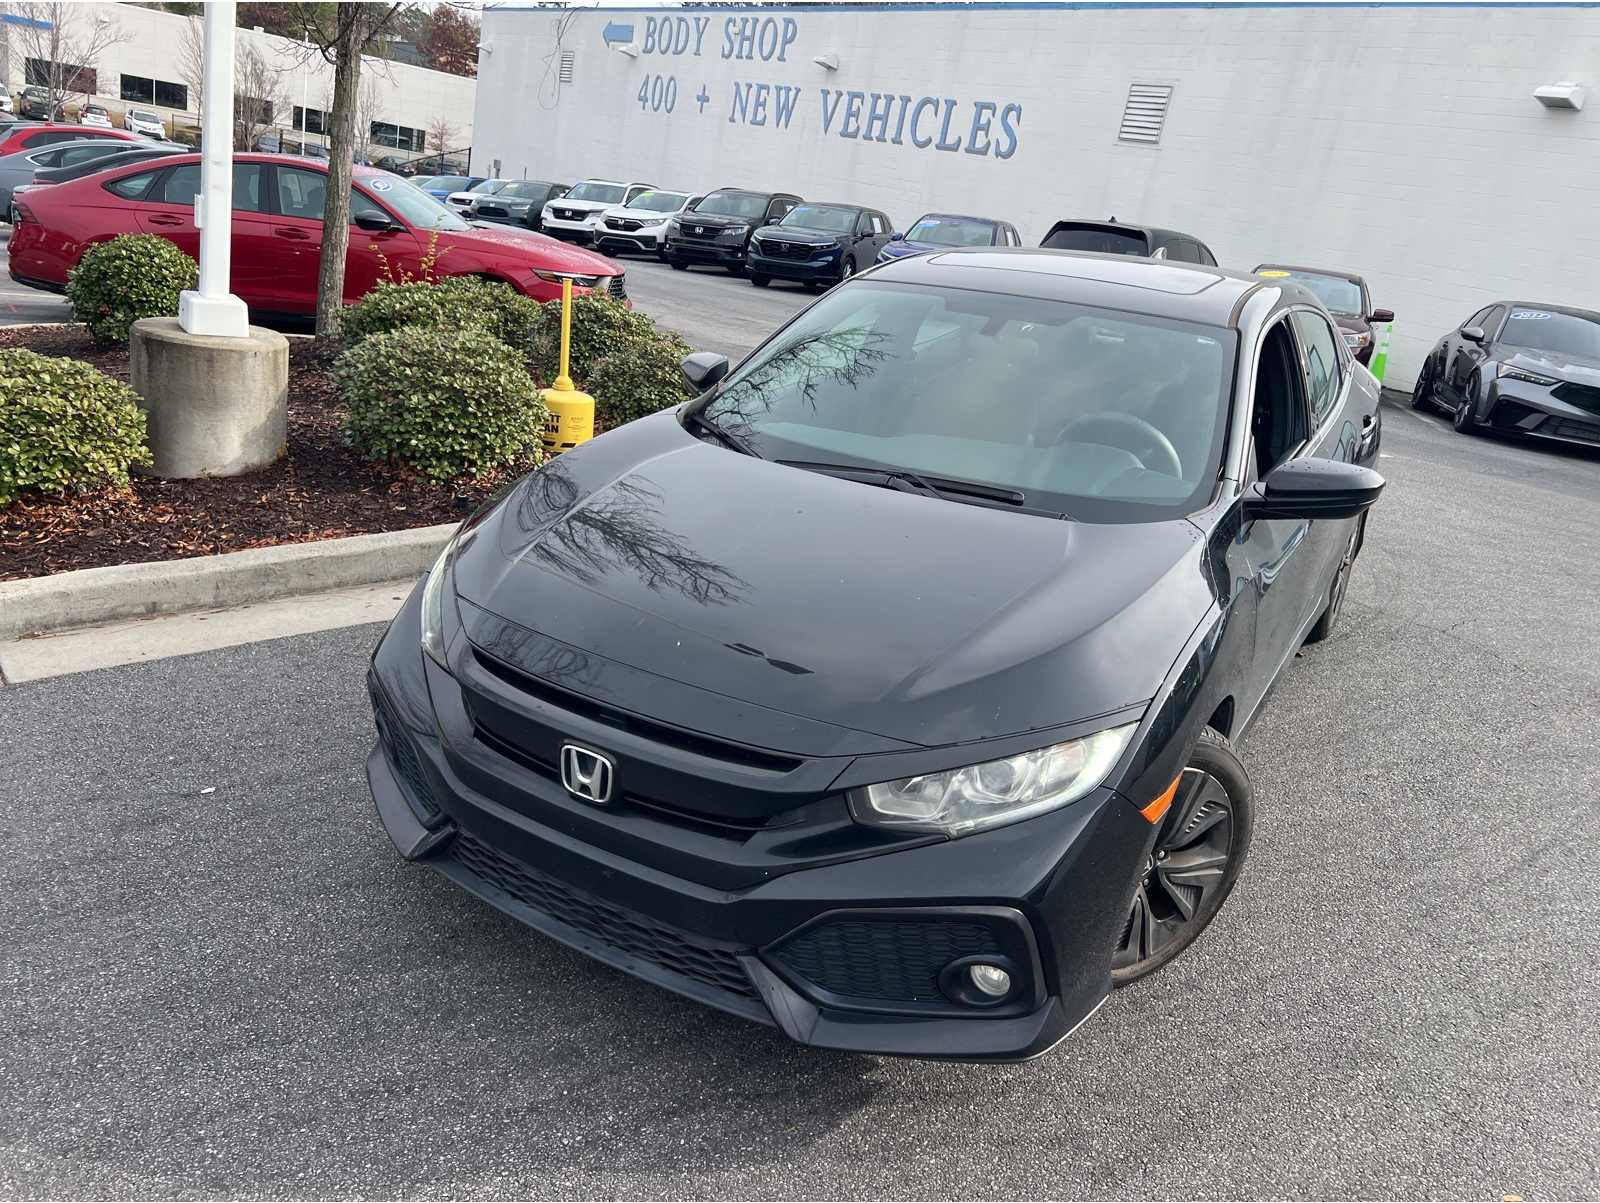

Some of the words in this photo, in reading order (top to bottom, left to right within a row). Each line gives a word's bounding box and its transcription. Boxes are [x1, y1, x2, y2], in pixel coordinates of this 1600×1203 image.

[642, 15, 710, 56] BODY
[721, 16, 798, 62] SHOP
[638, 73, 677, 114] 400
[696, 83, 710, 114] +
[729, 81, 801, 129] NEW
[820, 88, 1023, 160] VEHICLES
